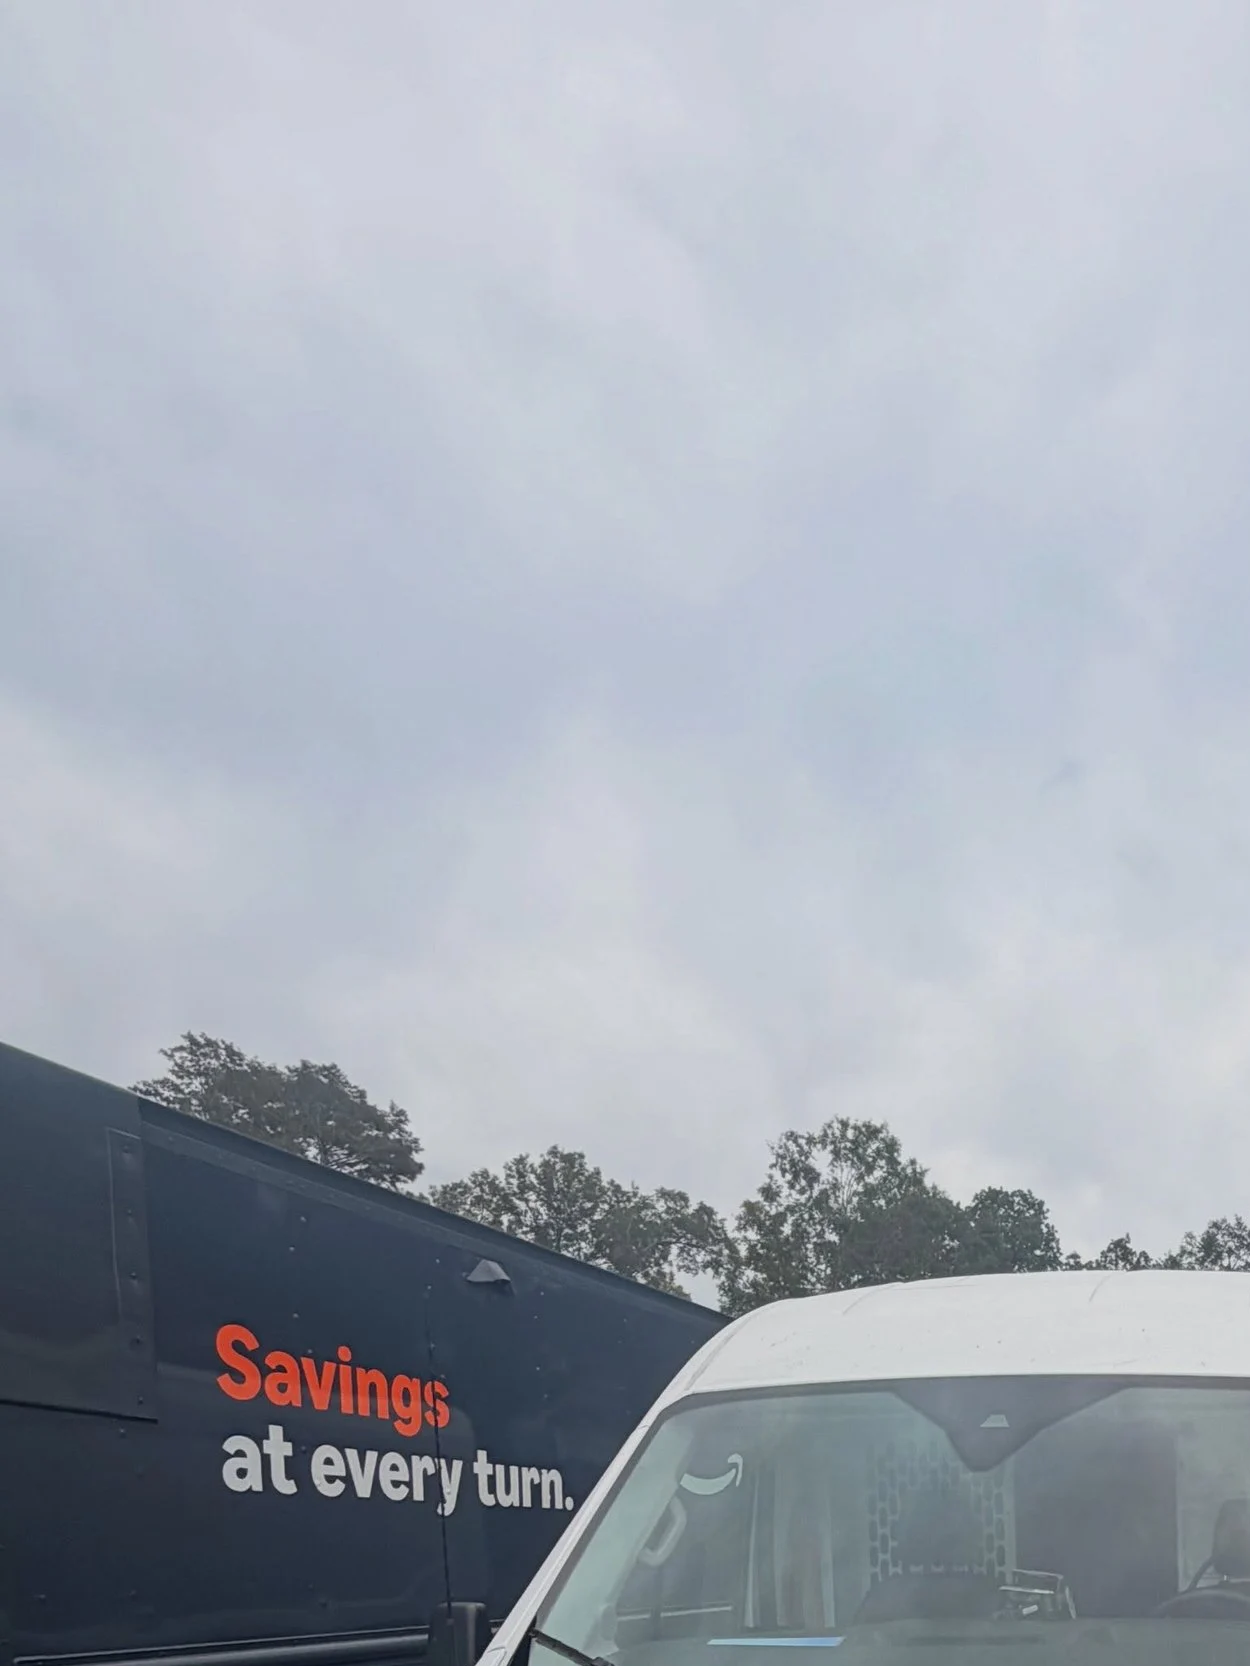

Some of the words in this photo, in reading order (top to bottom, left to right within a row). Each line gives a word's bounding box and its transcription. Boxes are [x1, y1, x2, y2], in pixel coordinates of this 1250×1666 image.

[215, 1324, 450, 1437] Savings
[221, 1424, 298, 1495] at
[310, 1445, 463, 1516] every
[473, 1449, 575, 1511] turn.
